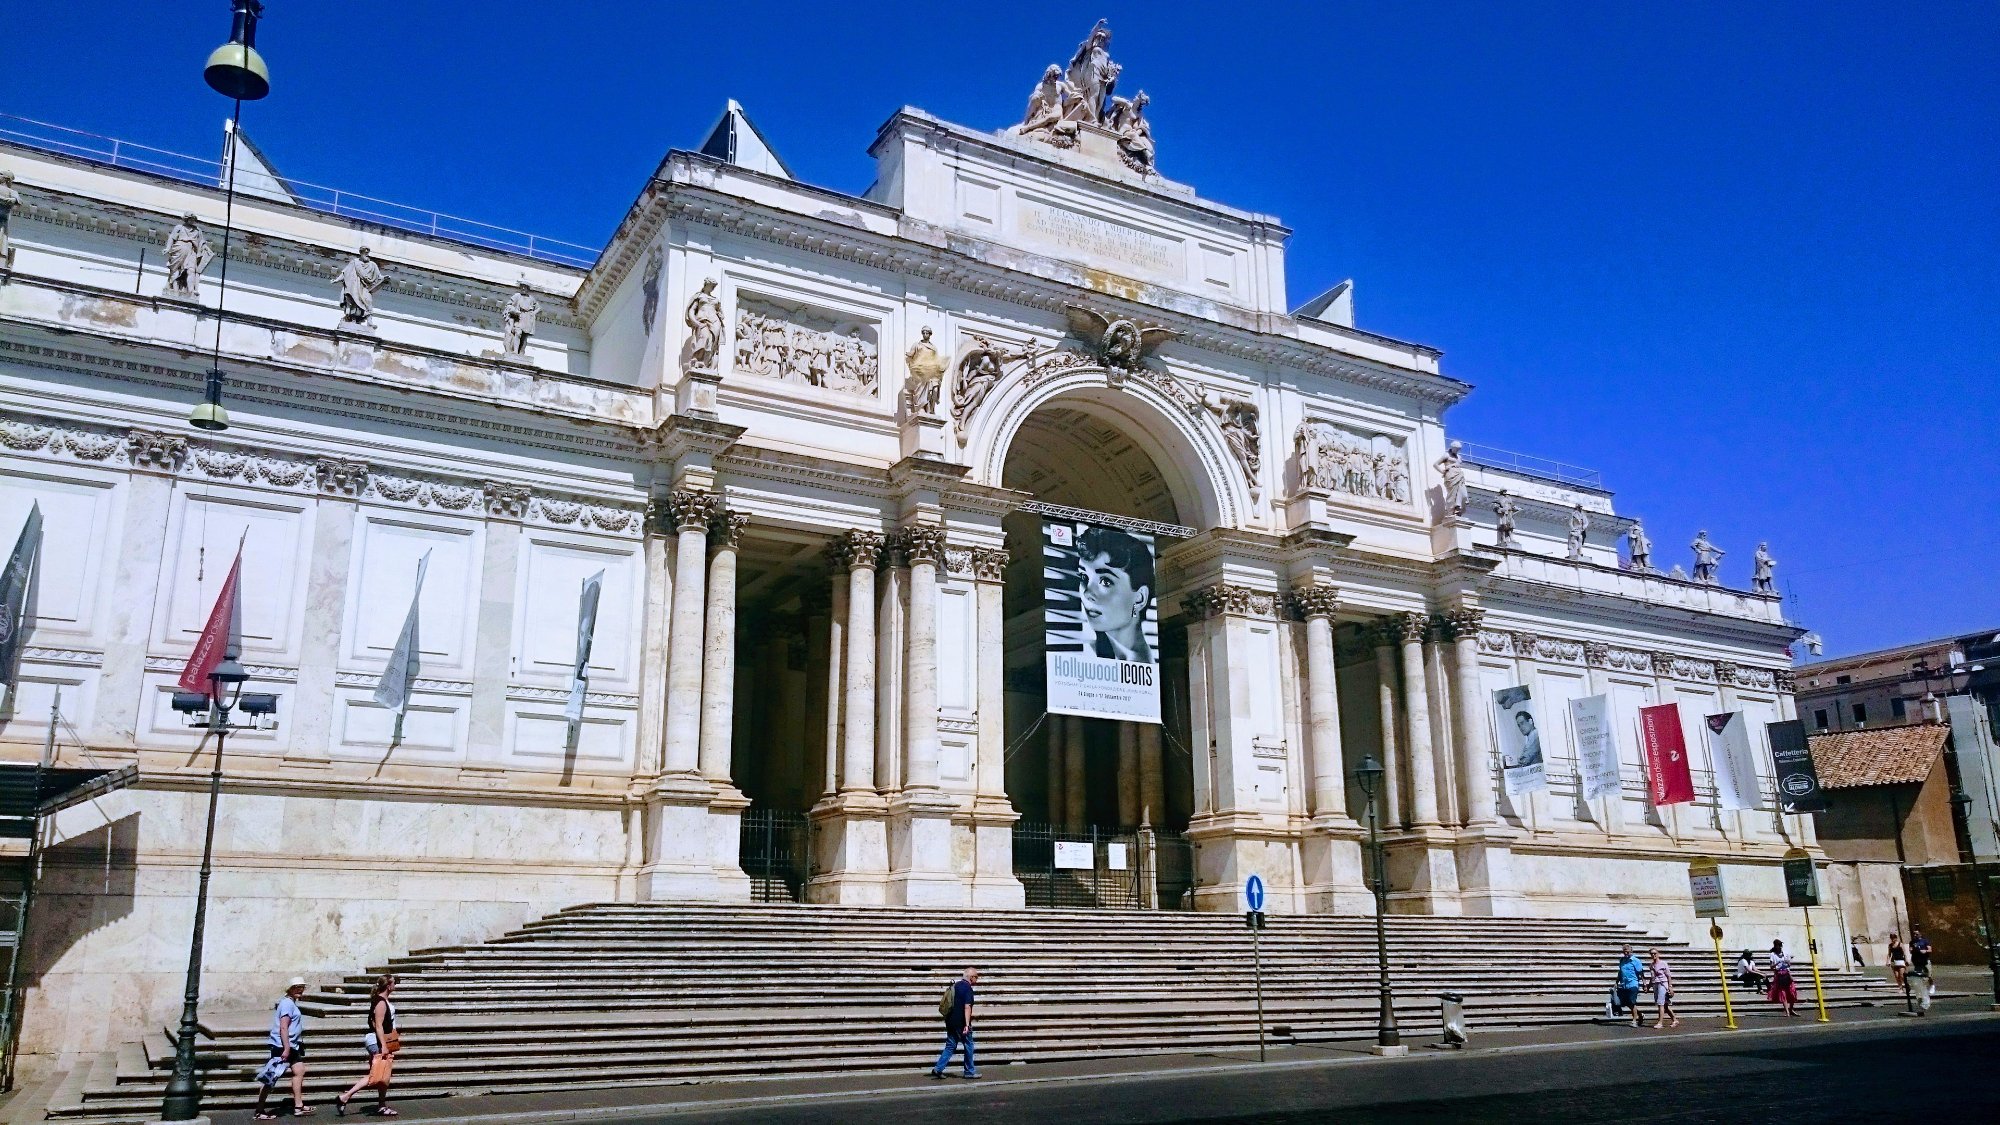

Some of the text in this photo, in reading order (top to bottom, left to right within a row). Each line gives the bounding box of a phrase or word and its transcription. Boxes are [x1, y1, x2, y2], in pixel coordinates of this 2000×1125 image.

[187, 634, 214, 684] palazzo
[1054, 655, 1119, 682] Hollywood
[1645, 714, 1659, 756] esposizioni
[1775, 748, 1809, 758] Caffetteria
